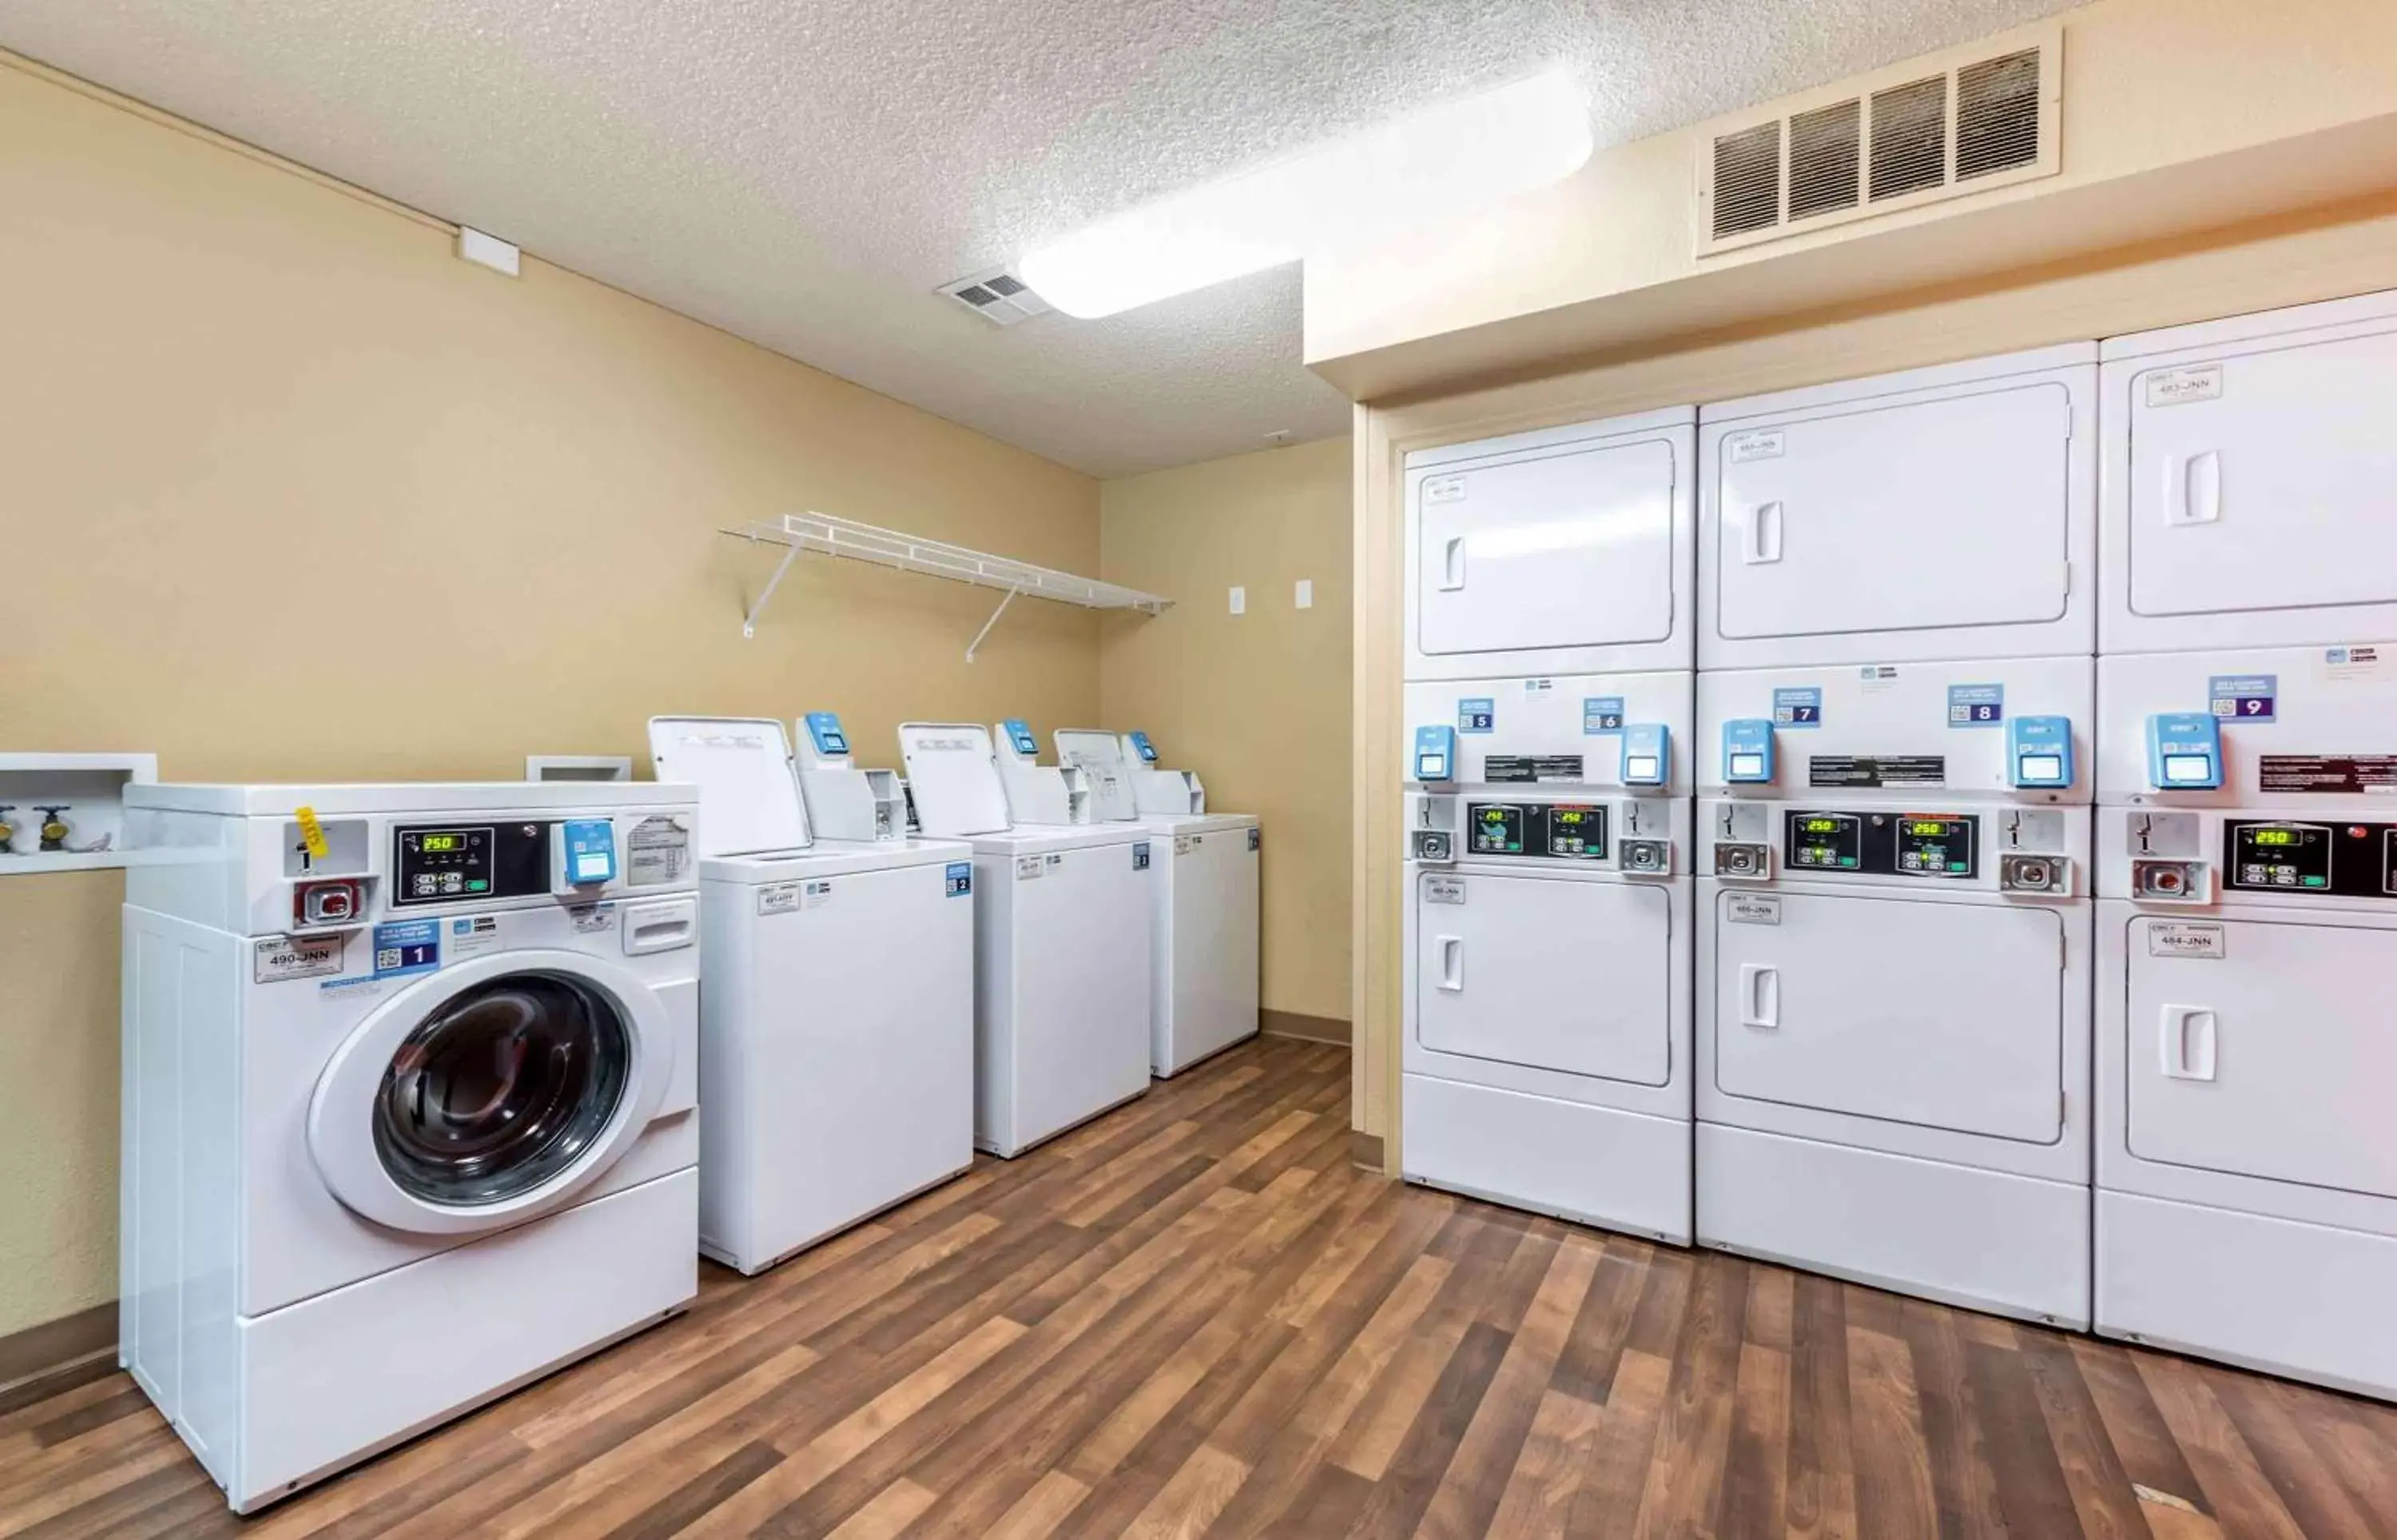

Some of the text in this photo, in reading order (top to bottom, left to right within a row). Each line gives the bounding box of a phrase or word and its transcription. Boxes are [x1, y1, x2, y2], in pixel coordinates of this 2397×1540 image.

[1799, 708, 1811, 720] 7
[1979, 706, 1991, 720] 8
[2246, 700, 2262, 715] 9
[1479, 716, 1487, 727] 5
[1606, 716, 1616, 728] 6
[423, 836, 452, 850] 250
[2256, 832, 2288, 843] 250
[960, 879, 967, 889] 2
[269, 949, 330, 965] 490-JNN
[414, 947, 423, 963] 1
